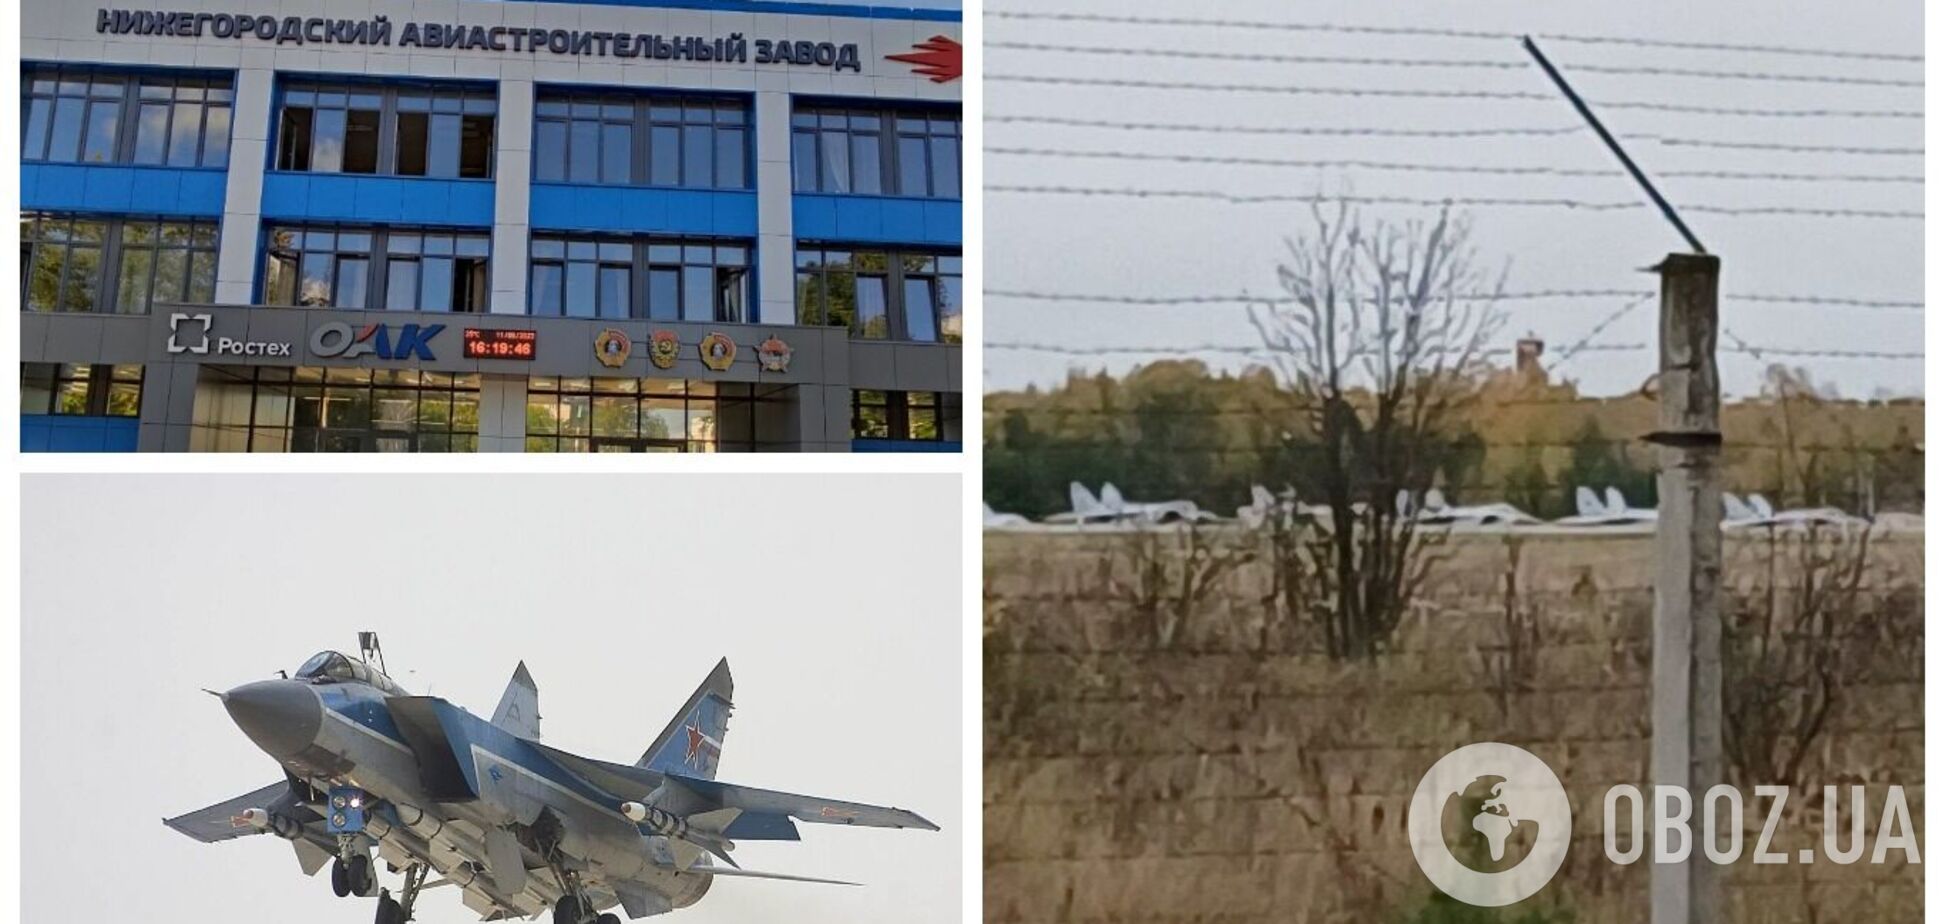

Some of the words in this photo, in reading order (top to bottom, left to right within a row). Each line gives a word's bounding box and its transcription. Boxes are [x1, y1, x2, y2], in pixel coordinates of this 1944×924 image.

[96, 9, 392, 46] НИЖЕГОРОДСКИЙ
[399, 22, 747, 63] АВИАСТРОИТЕЛЬНЫЙ
[755, 38, 861, 71] ЗАВОД
[217, 337, 291, 356] Ростех
[469, 341, 531, 355] 16:19:46
